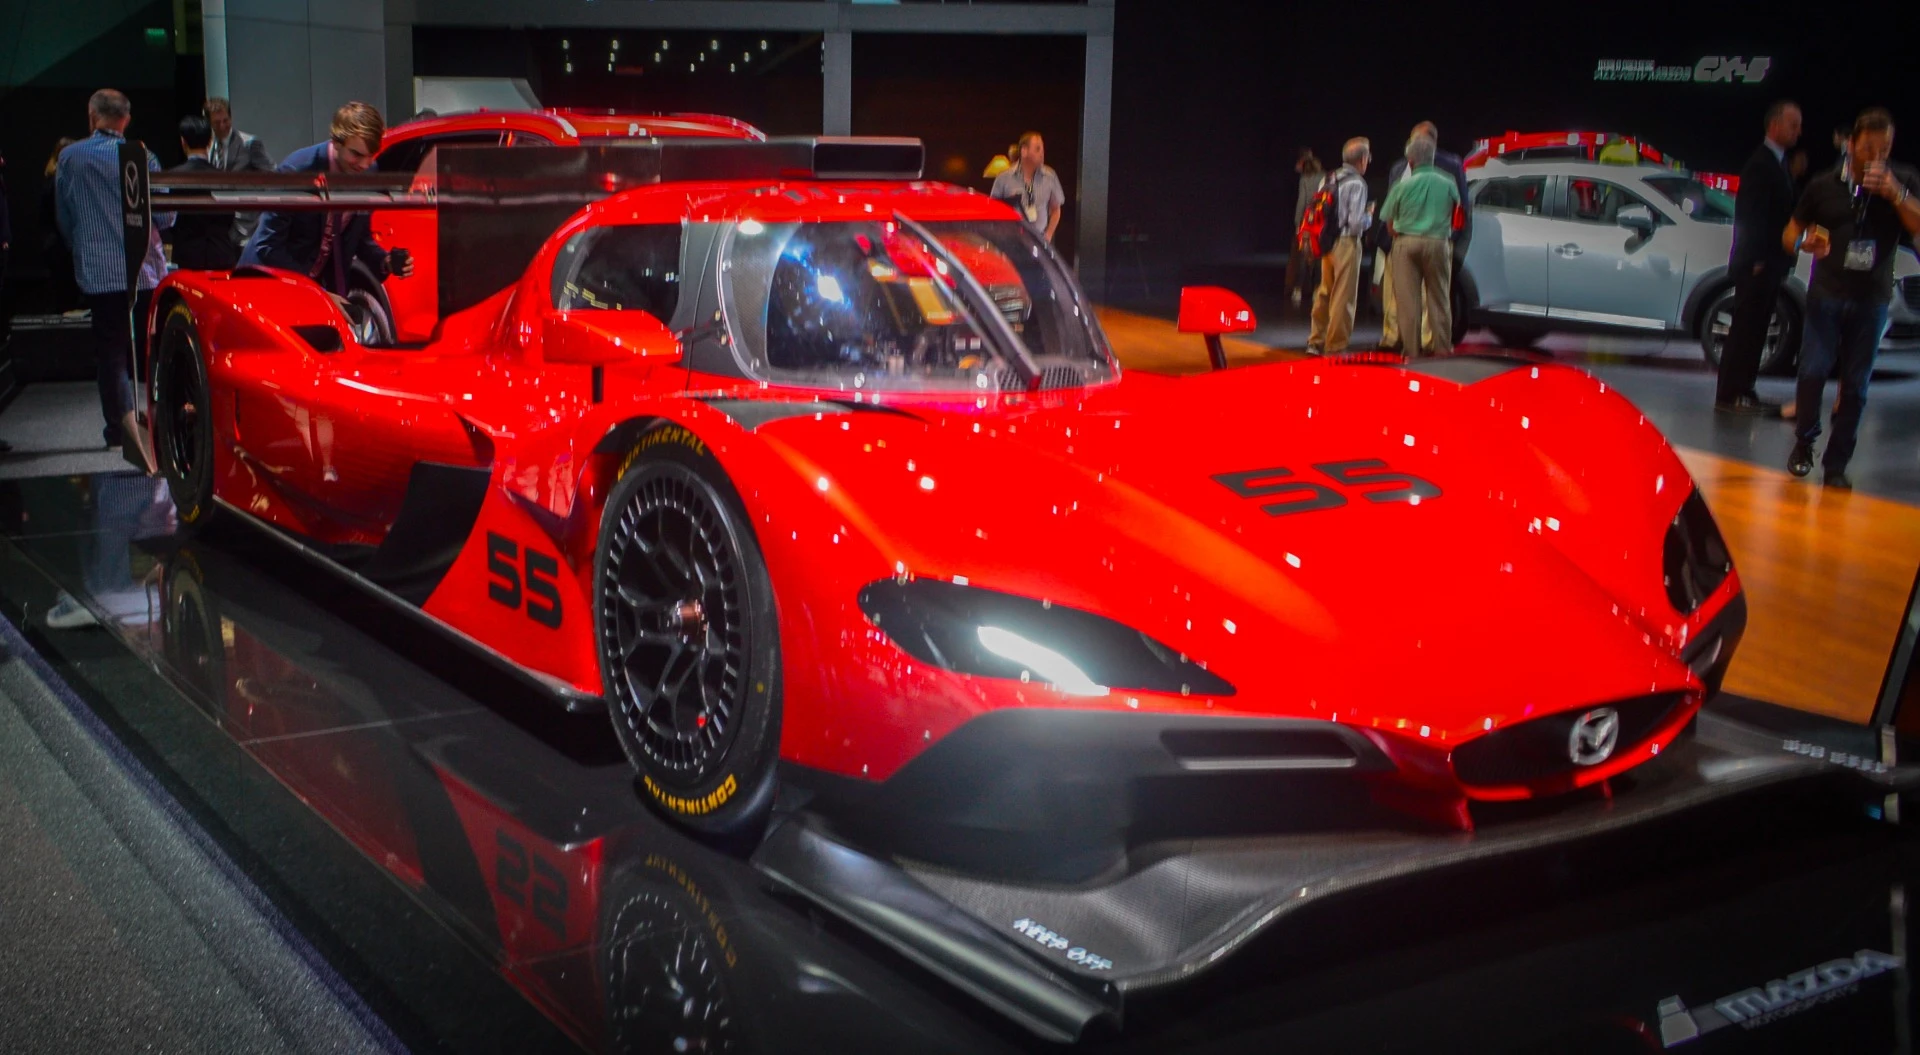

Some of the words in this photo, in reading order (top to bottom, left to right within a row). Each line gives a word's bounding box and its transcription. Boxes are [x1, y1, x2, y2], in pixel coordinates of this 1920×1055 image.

[617, 426, 704, 482] CONTINENTAL
[1209, 458, 1443, 517] 55
[487, 530, 563, 630] 55
[643, 774, 737, 815] CONTINENTAL
[1013, 918, 1068, 950] KEEP
[1066, 947, 1113, 970] OFF
